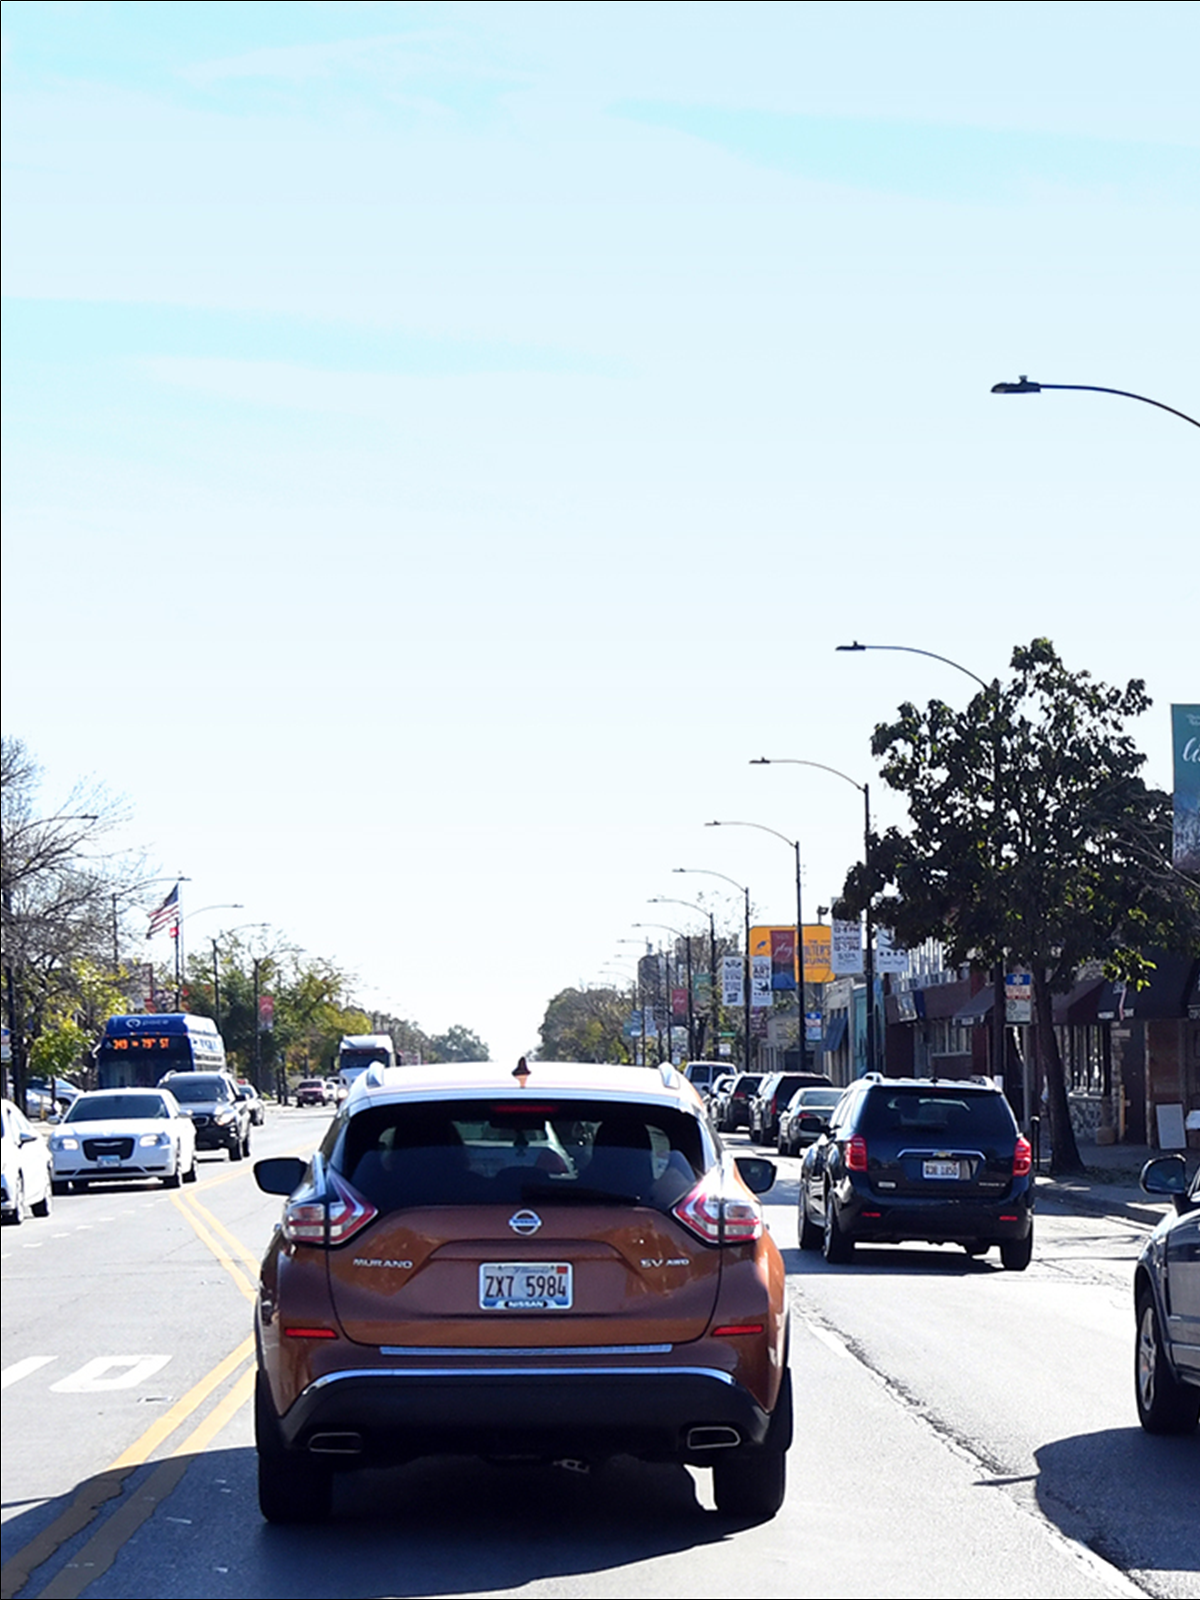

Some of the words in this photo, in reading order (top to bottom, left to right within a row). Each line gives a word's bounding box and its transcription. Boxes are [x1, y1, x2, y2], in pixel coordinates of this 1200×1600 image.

[353, 1258, 413, 1269] MURANO
[641, 1258, 664, 1268] SV
[485, 1275, 515, 1298] ZX7
[526, 1275, 566, 1298] 5984
